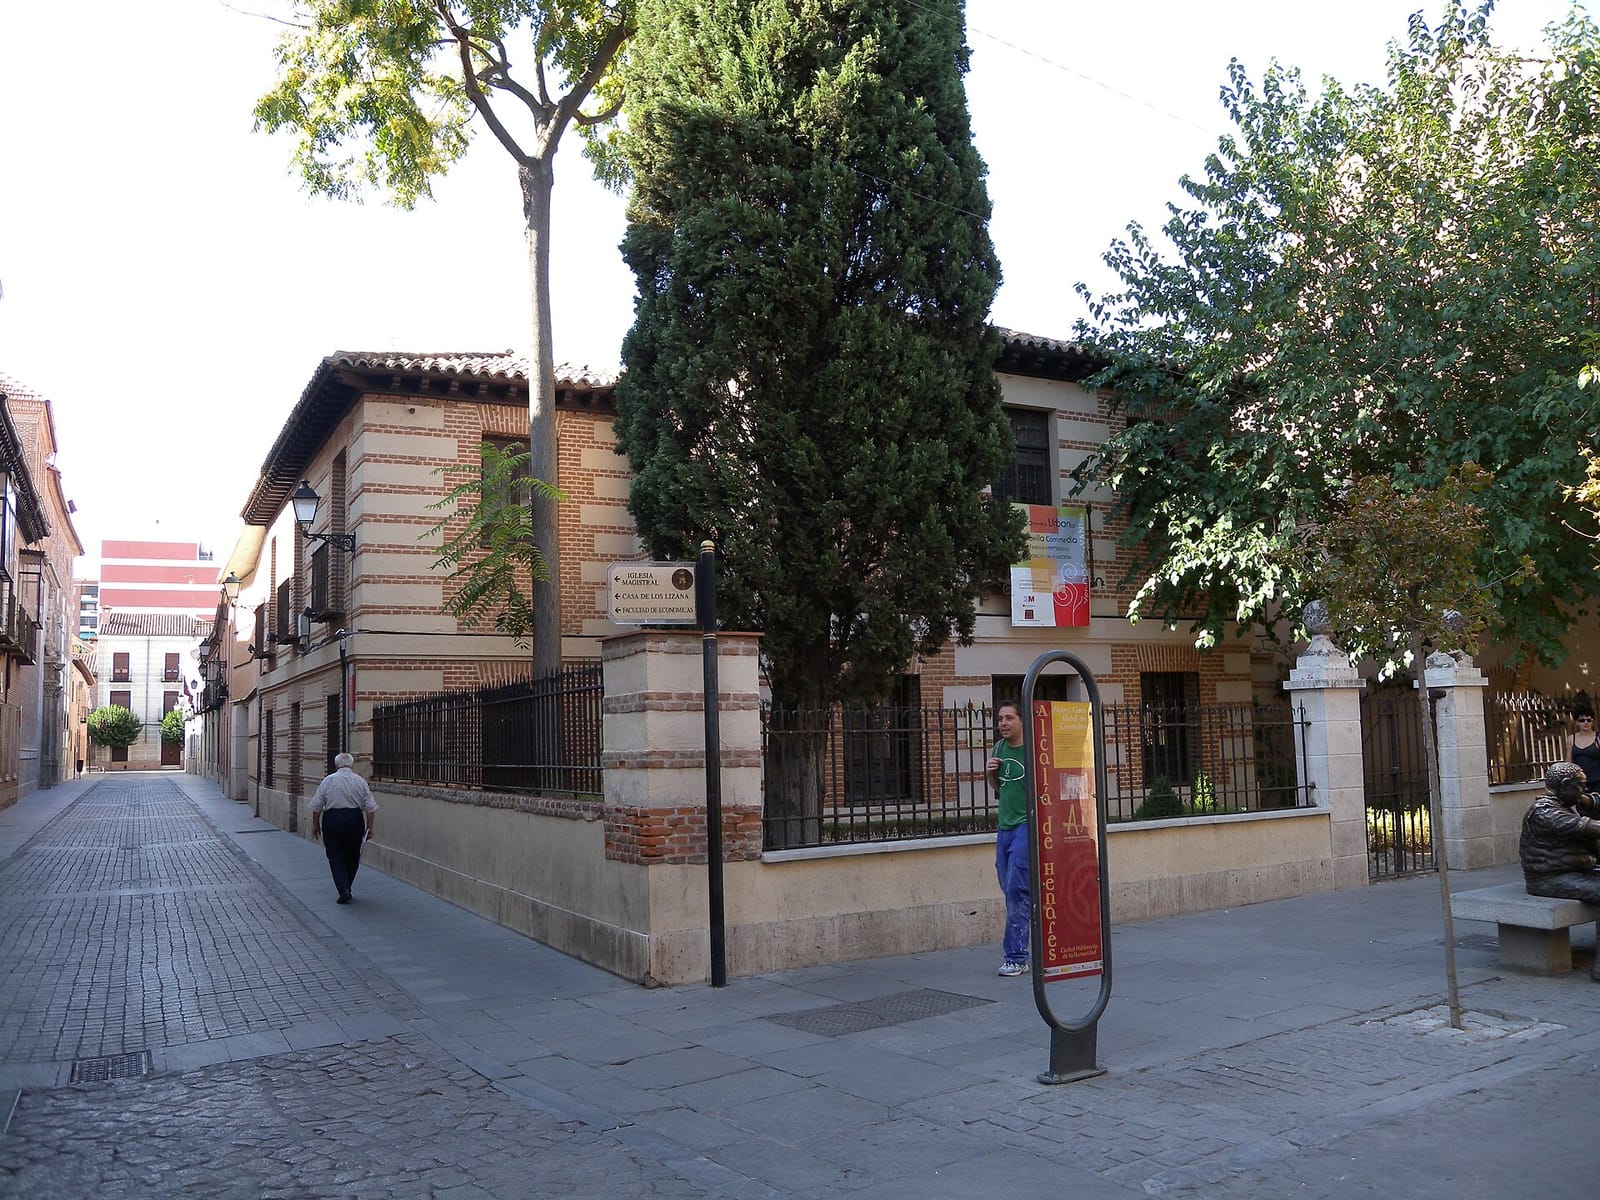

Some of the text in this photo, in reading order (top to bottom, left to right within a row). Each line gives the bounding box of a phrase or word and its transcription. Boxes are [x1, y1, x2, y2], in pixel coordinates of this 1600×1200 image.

[1046, 535, 1078, 543] Commedia
[1037, 704, 1057, 961] Alcalá de Henares
